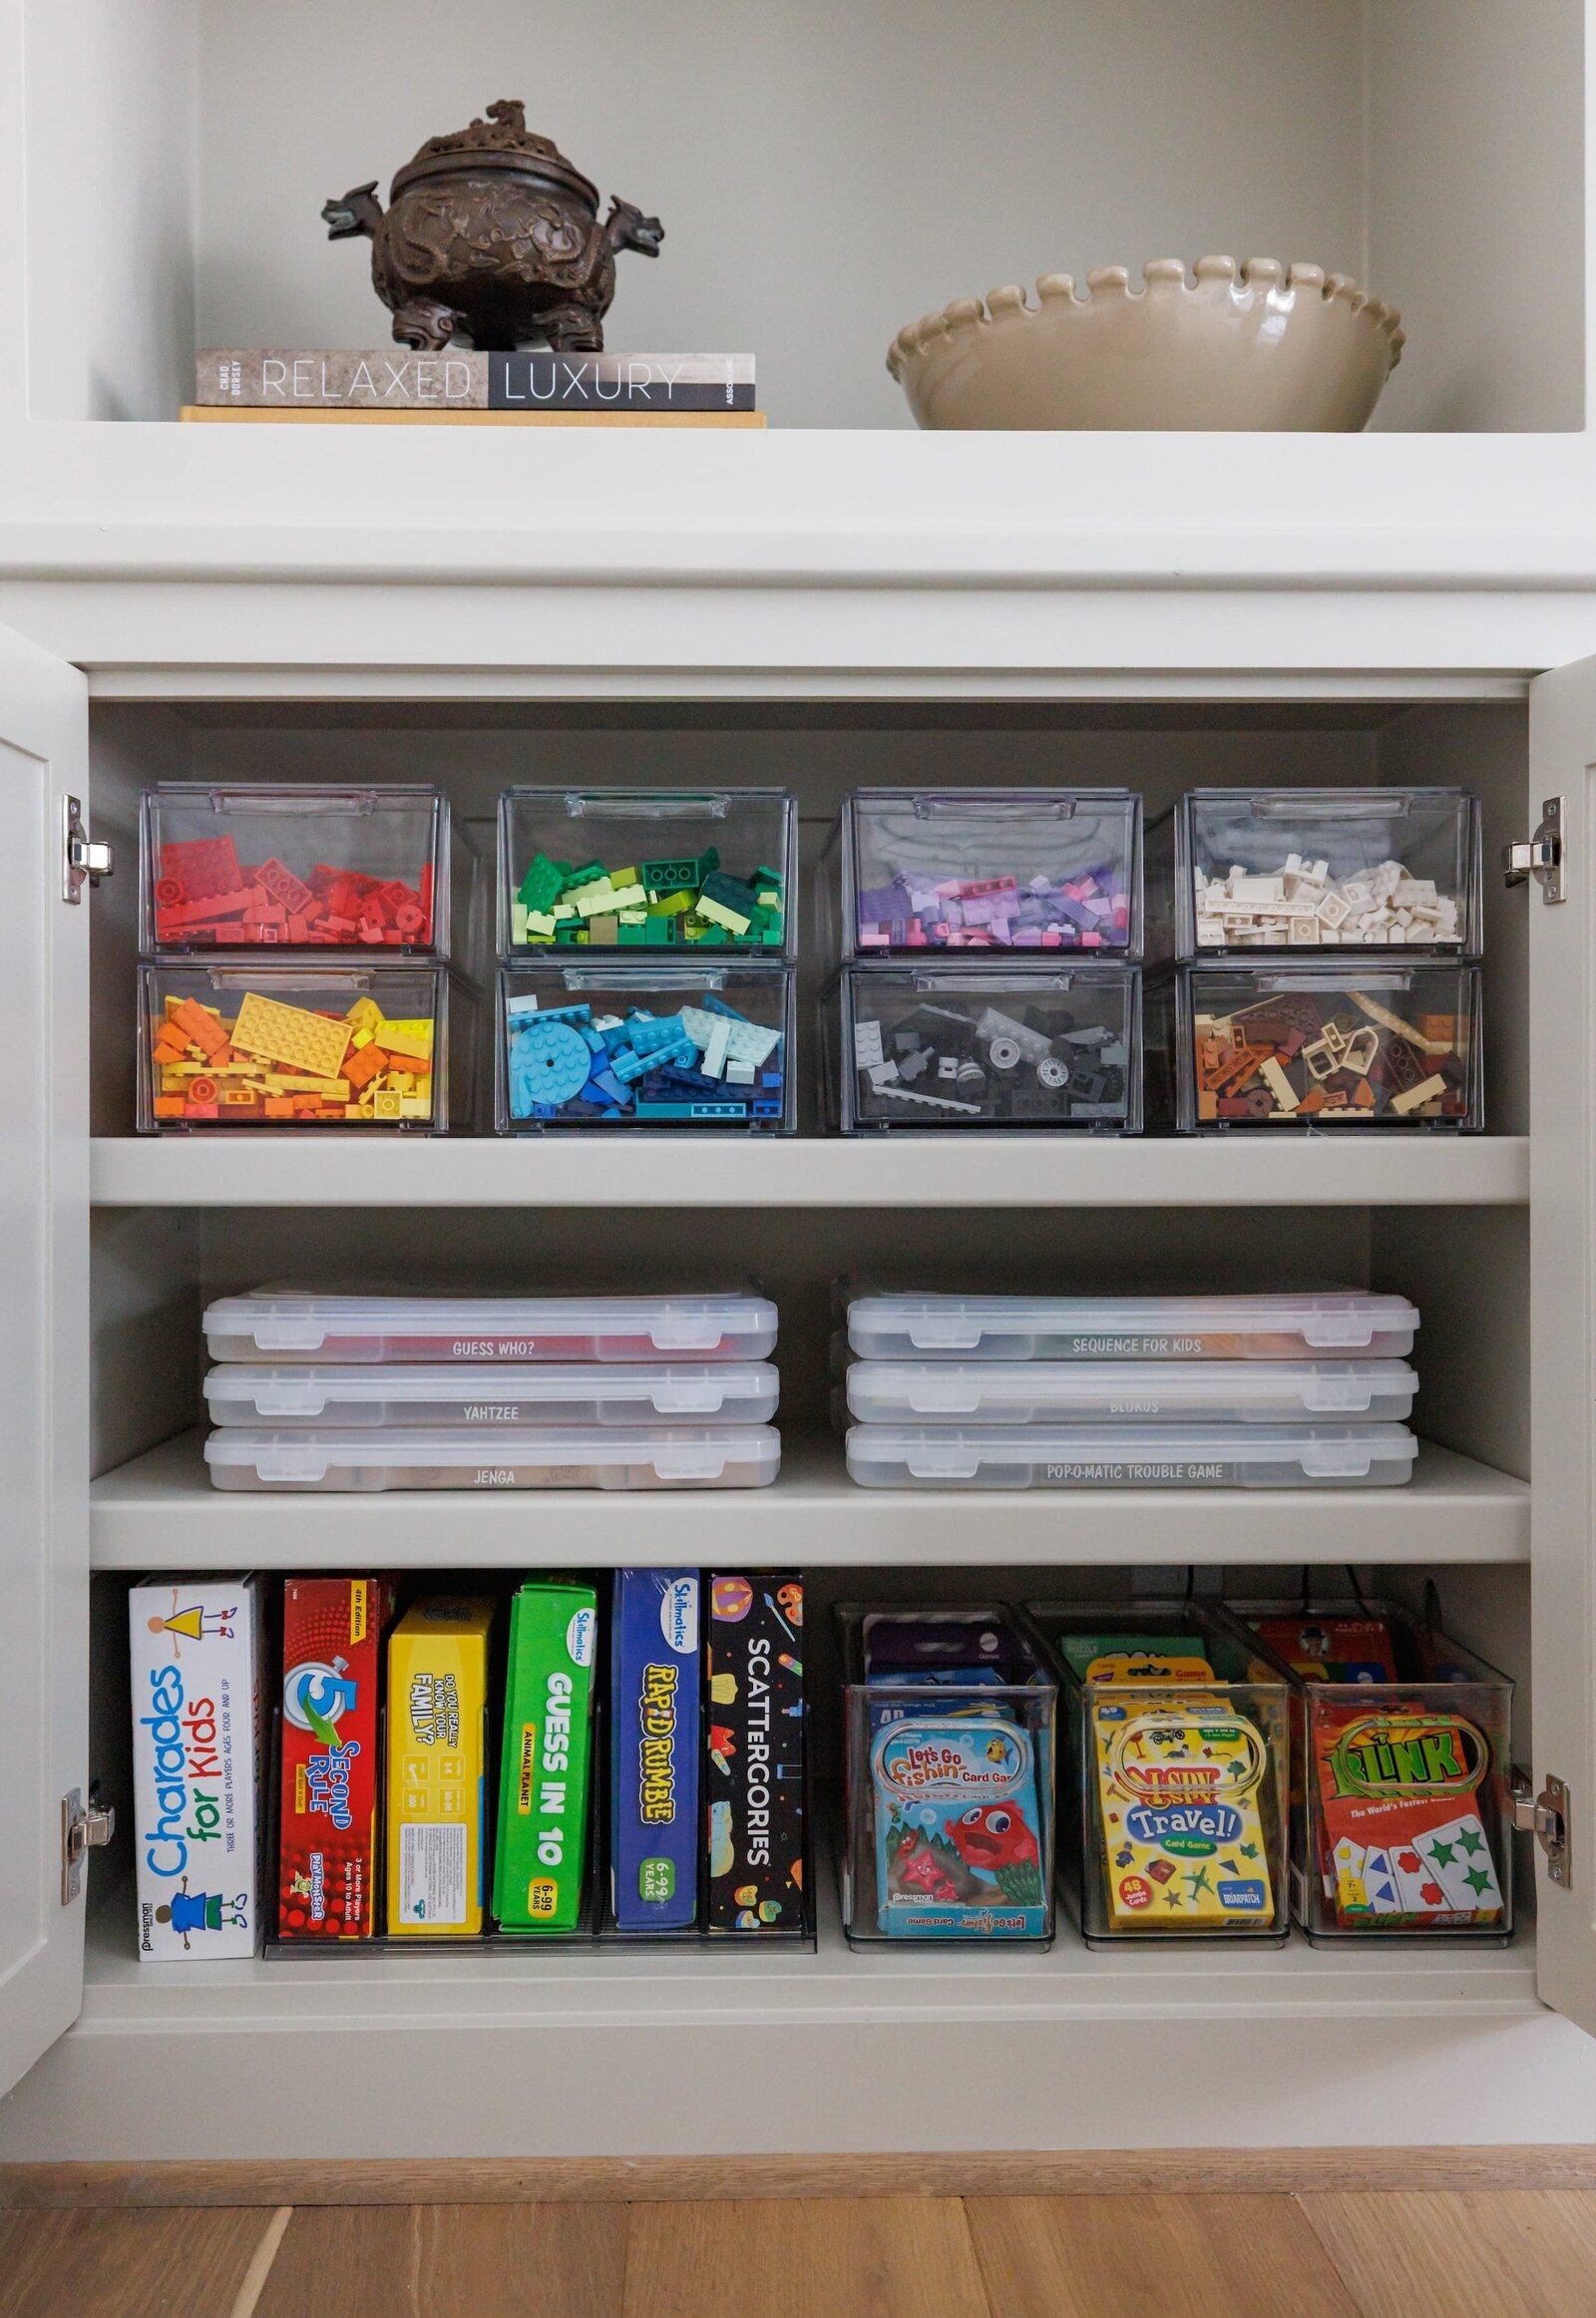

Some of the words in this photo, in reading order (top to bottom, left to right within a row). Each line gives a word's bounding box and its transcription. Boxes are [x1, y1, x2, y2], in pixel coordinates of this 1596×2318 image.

[219, 365, 229, 391] CHAD
[231, 360, 241, 396] DORSEY
[262, 359, 471, 398] RELAXED
[505, 362, 684, 400] LUXURY
[453, 1342, 494, 1355] GUESS
[499, 1341, 535, 1355] WHO?
[1072, 1339, 1138, 1353] SEQUENCE
[1143, 1339, 1168, 1352] FOR
[1173, 1339, 1202, 1353] KIDS
[463, 1405, 519, 1420] YAHTZEE
[473, 1470, 516, 1484] JENGA
[1046, 1464, 1123, 1479] POP-O-MATIC
[1126, 1464, 1184, 1478] TROUBLE
[1187, 1464, 1223, 1478] GAME
[674, 1584, 690, 1648] Skillmatics
[575, 1612, 590, 1662] Skillmatics
[220, 1679, 230, 1690] UP
[296, 1674, 356, 1717] 5
[434, 1679, 446, 1711] KNOW
[445, 1674, 456, 1689] DO
[221, 1694, 230, 1709] AND
[410, 1673, 435, 1746] FAMILY?
[445, 1690, 458, 1711] YOU
[221, 1712, 231, 1732] FOUR
[435, 1712, 447, 1739] YOUR
[447, 1712, 459, 1748] REALLY
[542, 1672, 573, 1772] GUESS
[181, 1698, 222, 1778] Kids
[222, 1736, 231, 1753] AGES
[522, 1731, 533, 1770] ANIMAL
[747, 1638, 770, 1867] SCATTERGORIES
[908, 1746, 939, 1769] Let's
[942, 1748, 962, 1765] Go
[140, 1665, 189, 1877] Charades
[222, 1757, 233, 1789] PLAYERS
[304, 1755, 328, 1813] RULE
[329, 1741, 360, 1829] SECOND
[641, 1738, 675, 1821] RUMBLE
[963, 1772, 990, 1782] Card
[520, 1771, 531, 1807] PLANET
[539, 1781, 567, 1814] IN
[1150, 1771, 1163, 1805] I
[1166, 1771, 1212, 1805] SPY
[186, 1787, 222, 1842] for
[224, 1793, 234, 1814] MORE
[1351, 1809, 1366, 1819] The
[1367, 1803, 1397, 1815] World's
[225, 1817, 234, 1829] OR
[1131, 1809, 1237, 1839] Travel!
[225, 1831, 235, 1853] THREE
[537, 1825, 565, 1867] 10
[1165, 1839, 1185, 1848] Card
[1187, 1841, 1211, 1850] Game
[355, 1864, 361, 1873] or
[644, 1863, 654, 1897] YEARS
[656, 1862, 670, 1896] 6-99
[541, 1884, 553, 1911] 6-99
[1123, 1879, 1142, 1893] 48
[1125, 1891, 1147, 1901] Jumbo
[1129, 1897, 1147, 1906] Cards
